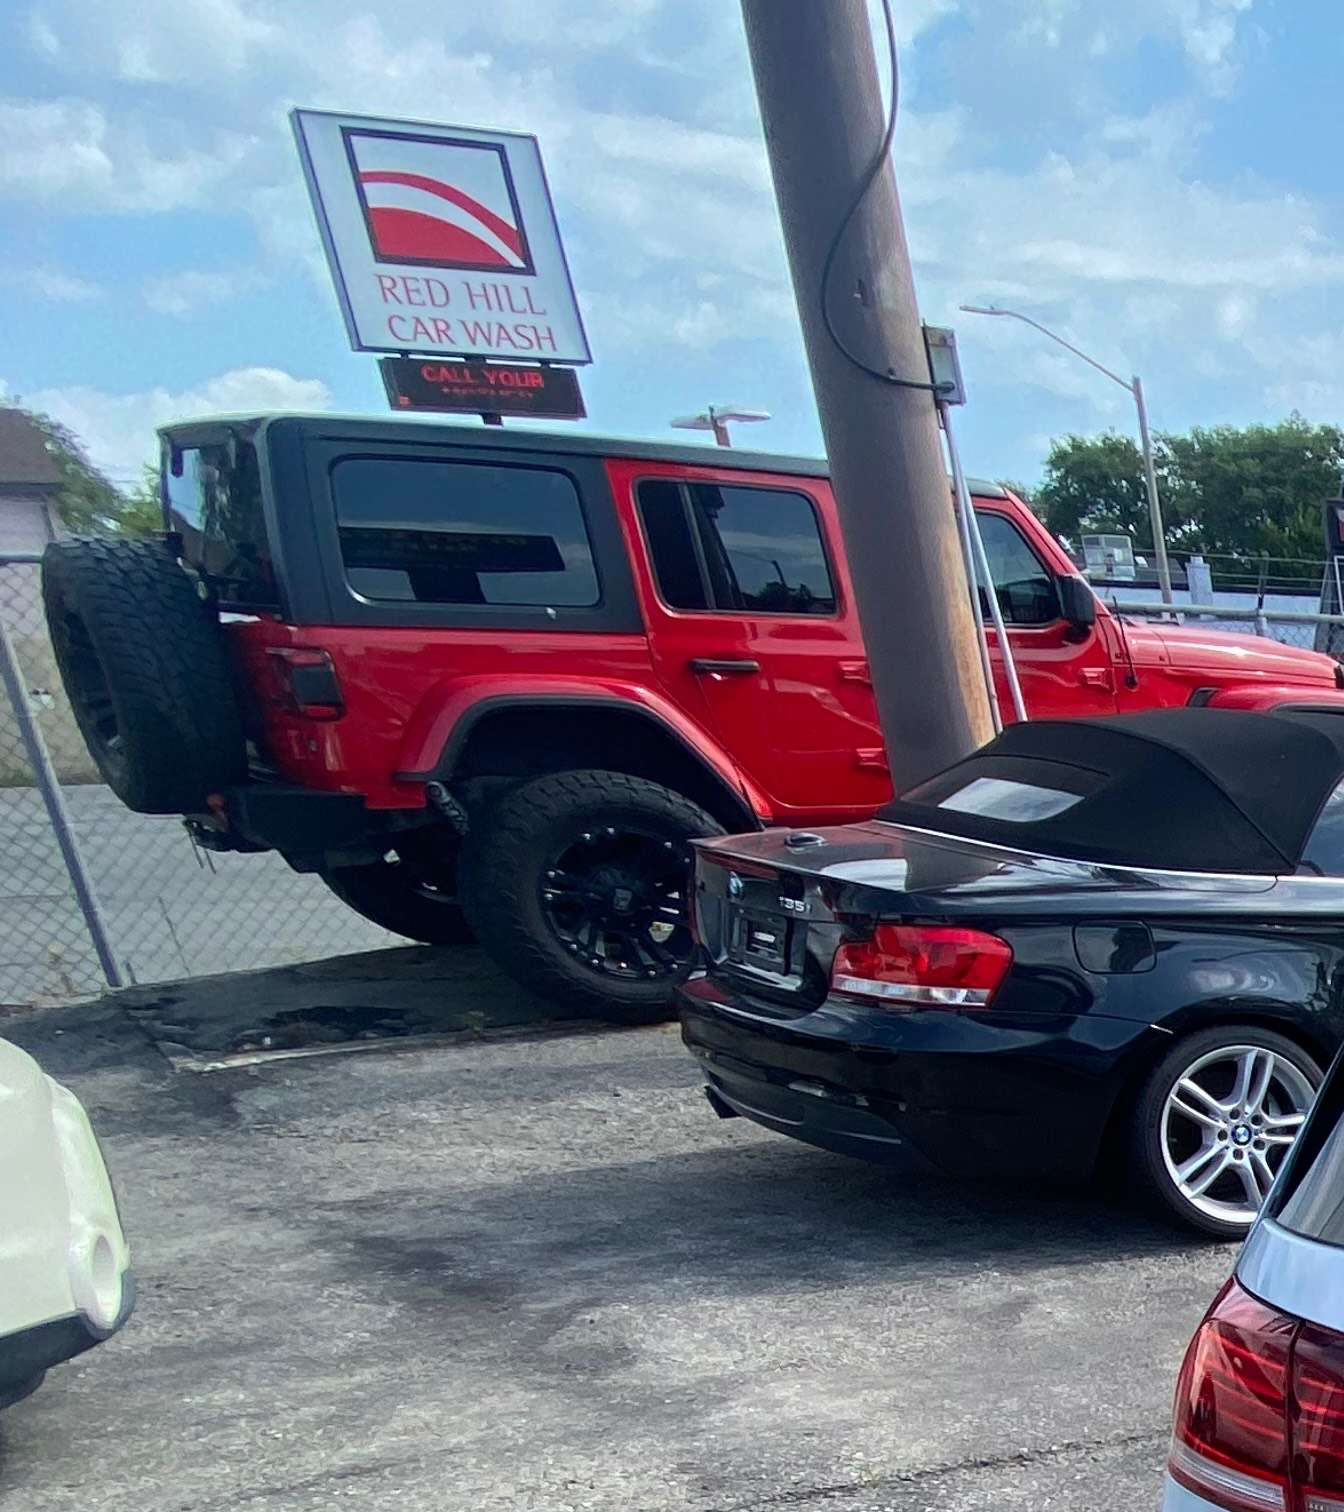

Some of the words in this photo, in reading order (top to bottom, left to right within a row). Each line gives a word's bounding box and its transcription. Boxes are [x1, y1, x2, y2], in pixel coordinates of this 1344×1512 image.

[373, 273, 450, 308] RED
[461, 280, 547, 316] HILL
[387, 314, 456, 345] CAR
[457, 318, 557, 351] WASH
[421, 364, 476, 383] CALL
[482, 368, 544, 388] YOUR
